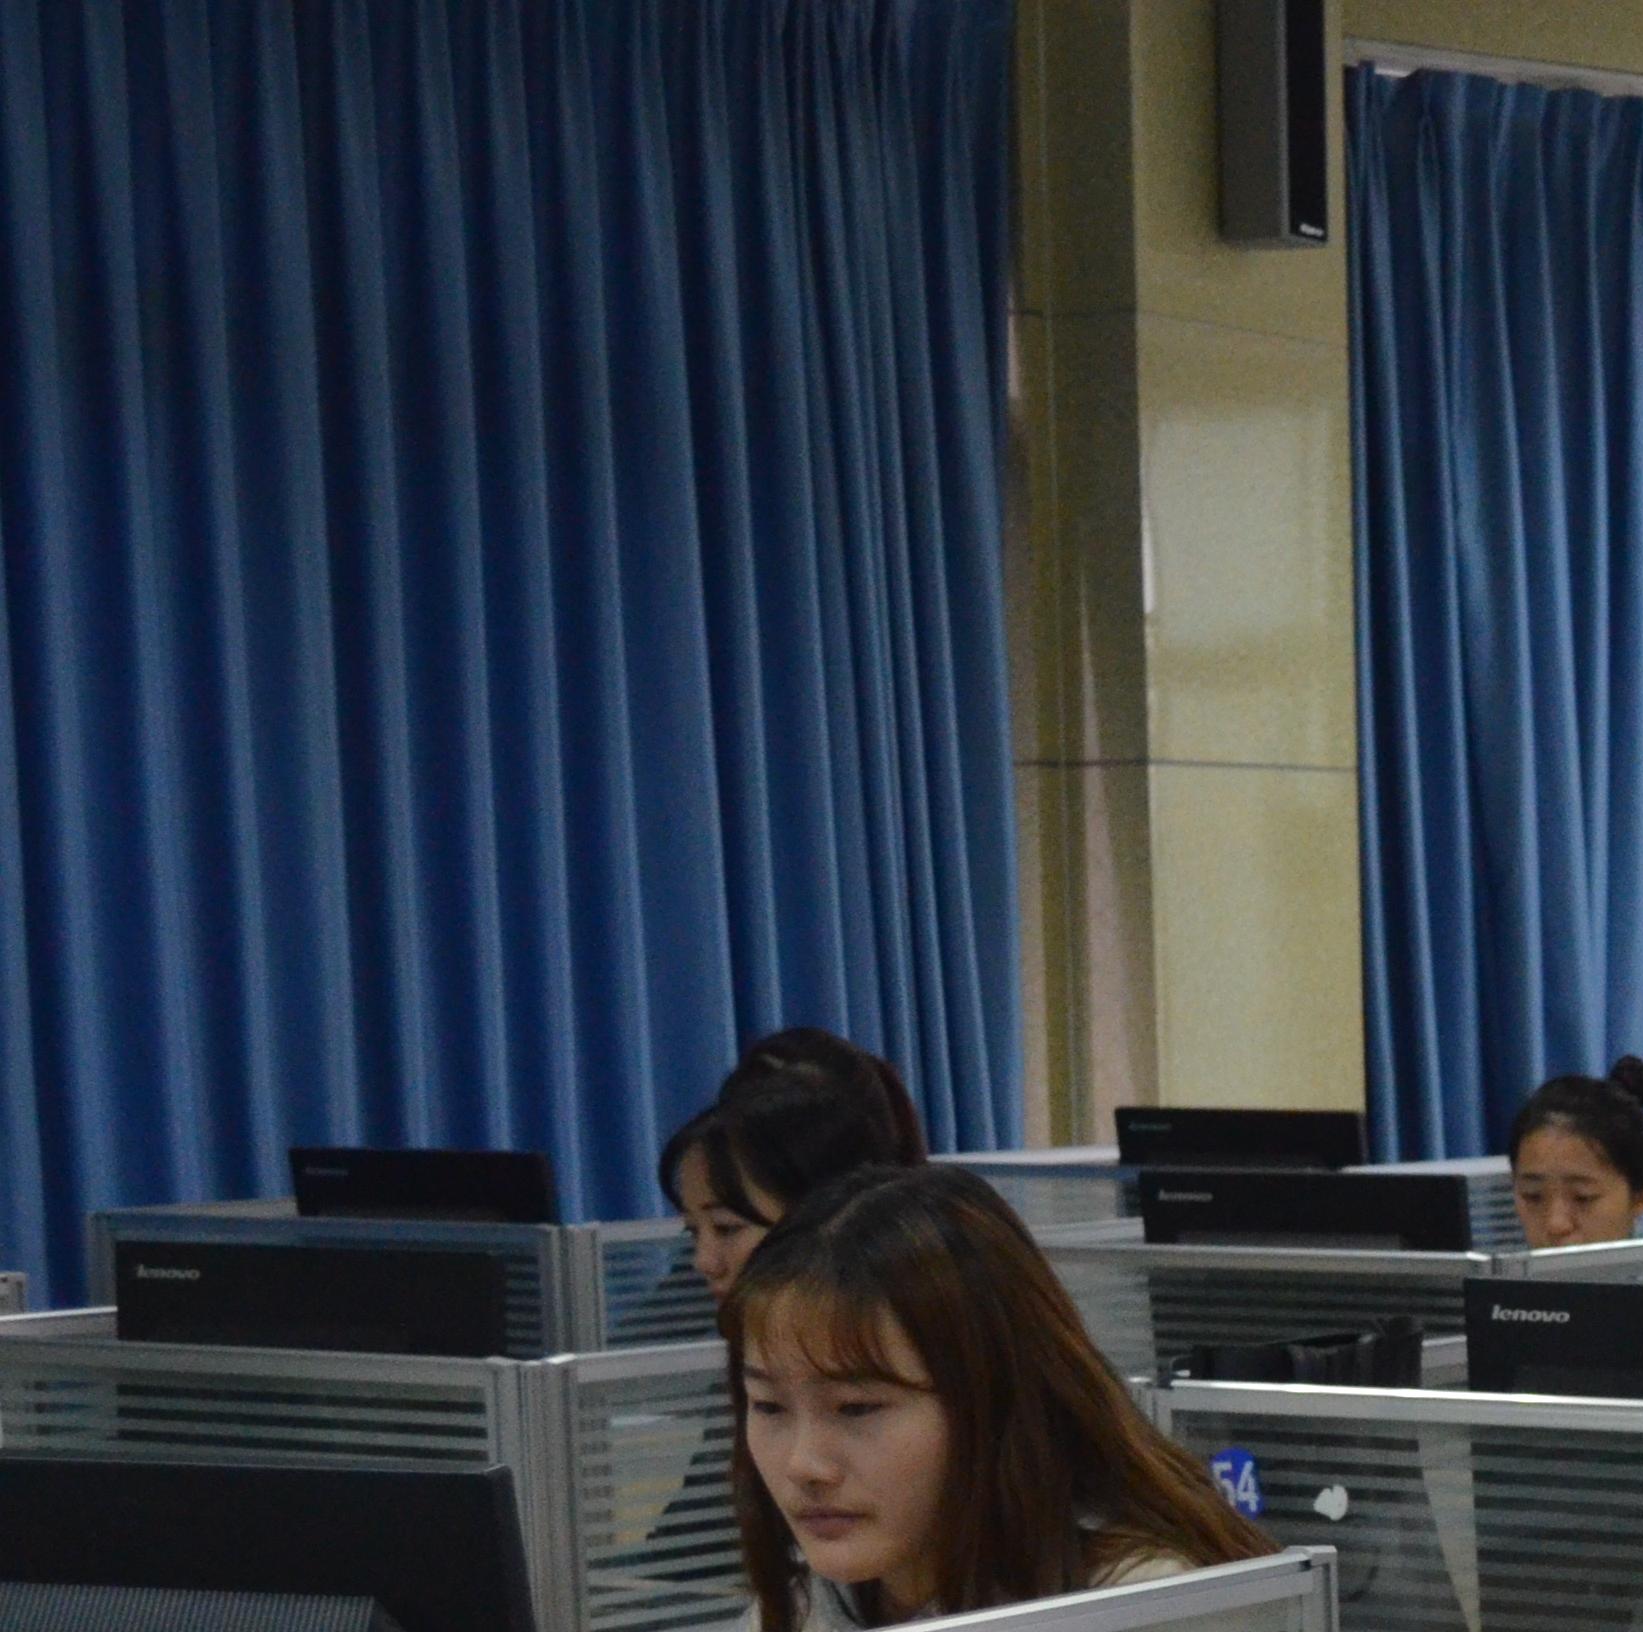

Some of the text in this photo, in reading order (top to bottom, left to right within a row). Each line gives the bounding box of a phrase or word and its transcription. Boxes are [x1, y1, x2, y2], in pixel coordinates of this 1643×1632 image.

[135, 1262, 202, 1281] lenovo
[1490, 1303, 1571, 1323] lenovo
[1212, 1460, 1259, 1512] 54
